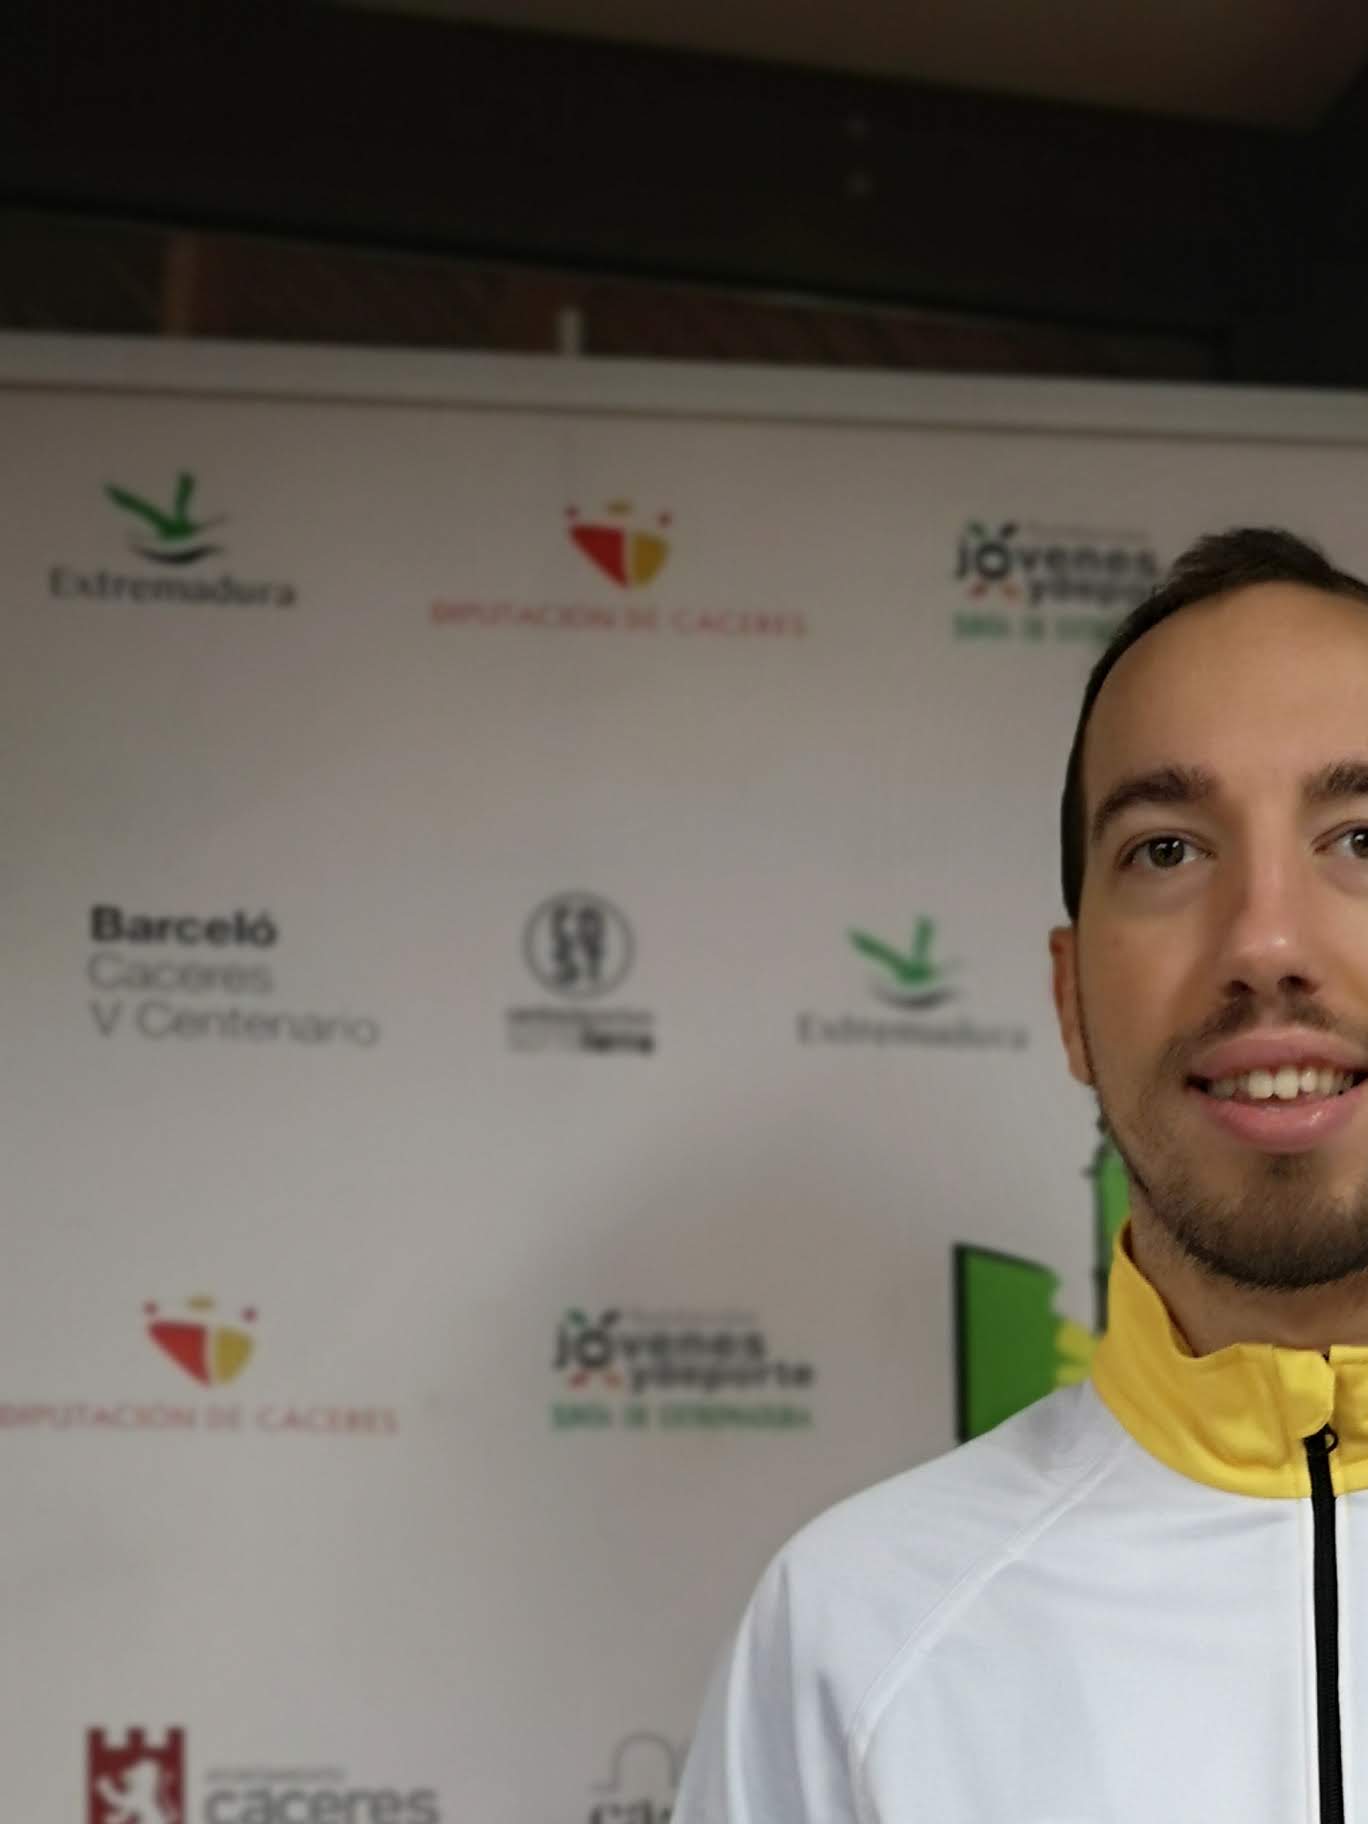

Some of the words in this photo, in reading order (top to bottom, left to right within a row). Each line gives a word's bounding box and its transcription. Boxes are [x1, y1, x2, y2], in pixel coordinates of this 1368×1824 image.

[91, 904, 278, 946] Barceló
[90, 1000, 123, 1037] V
[137, 1001, 382, 1047] Centenario
